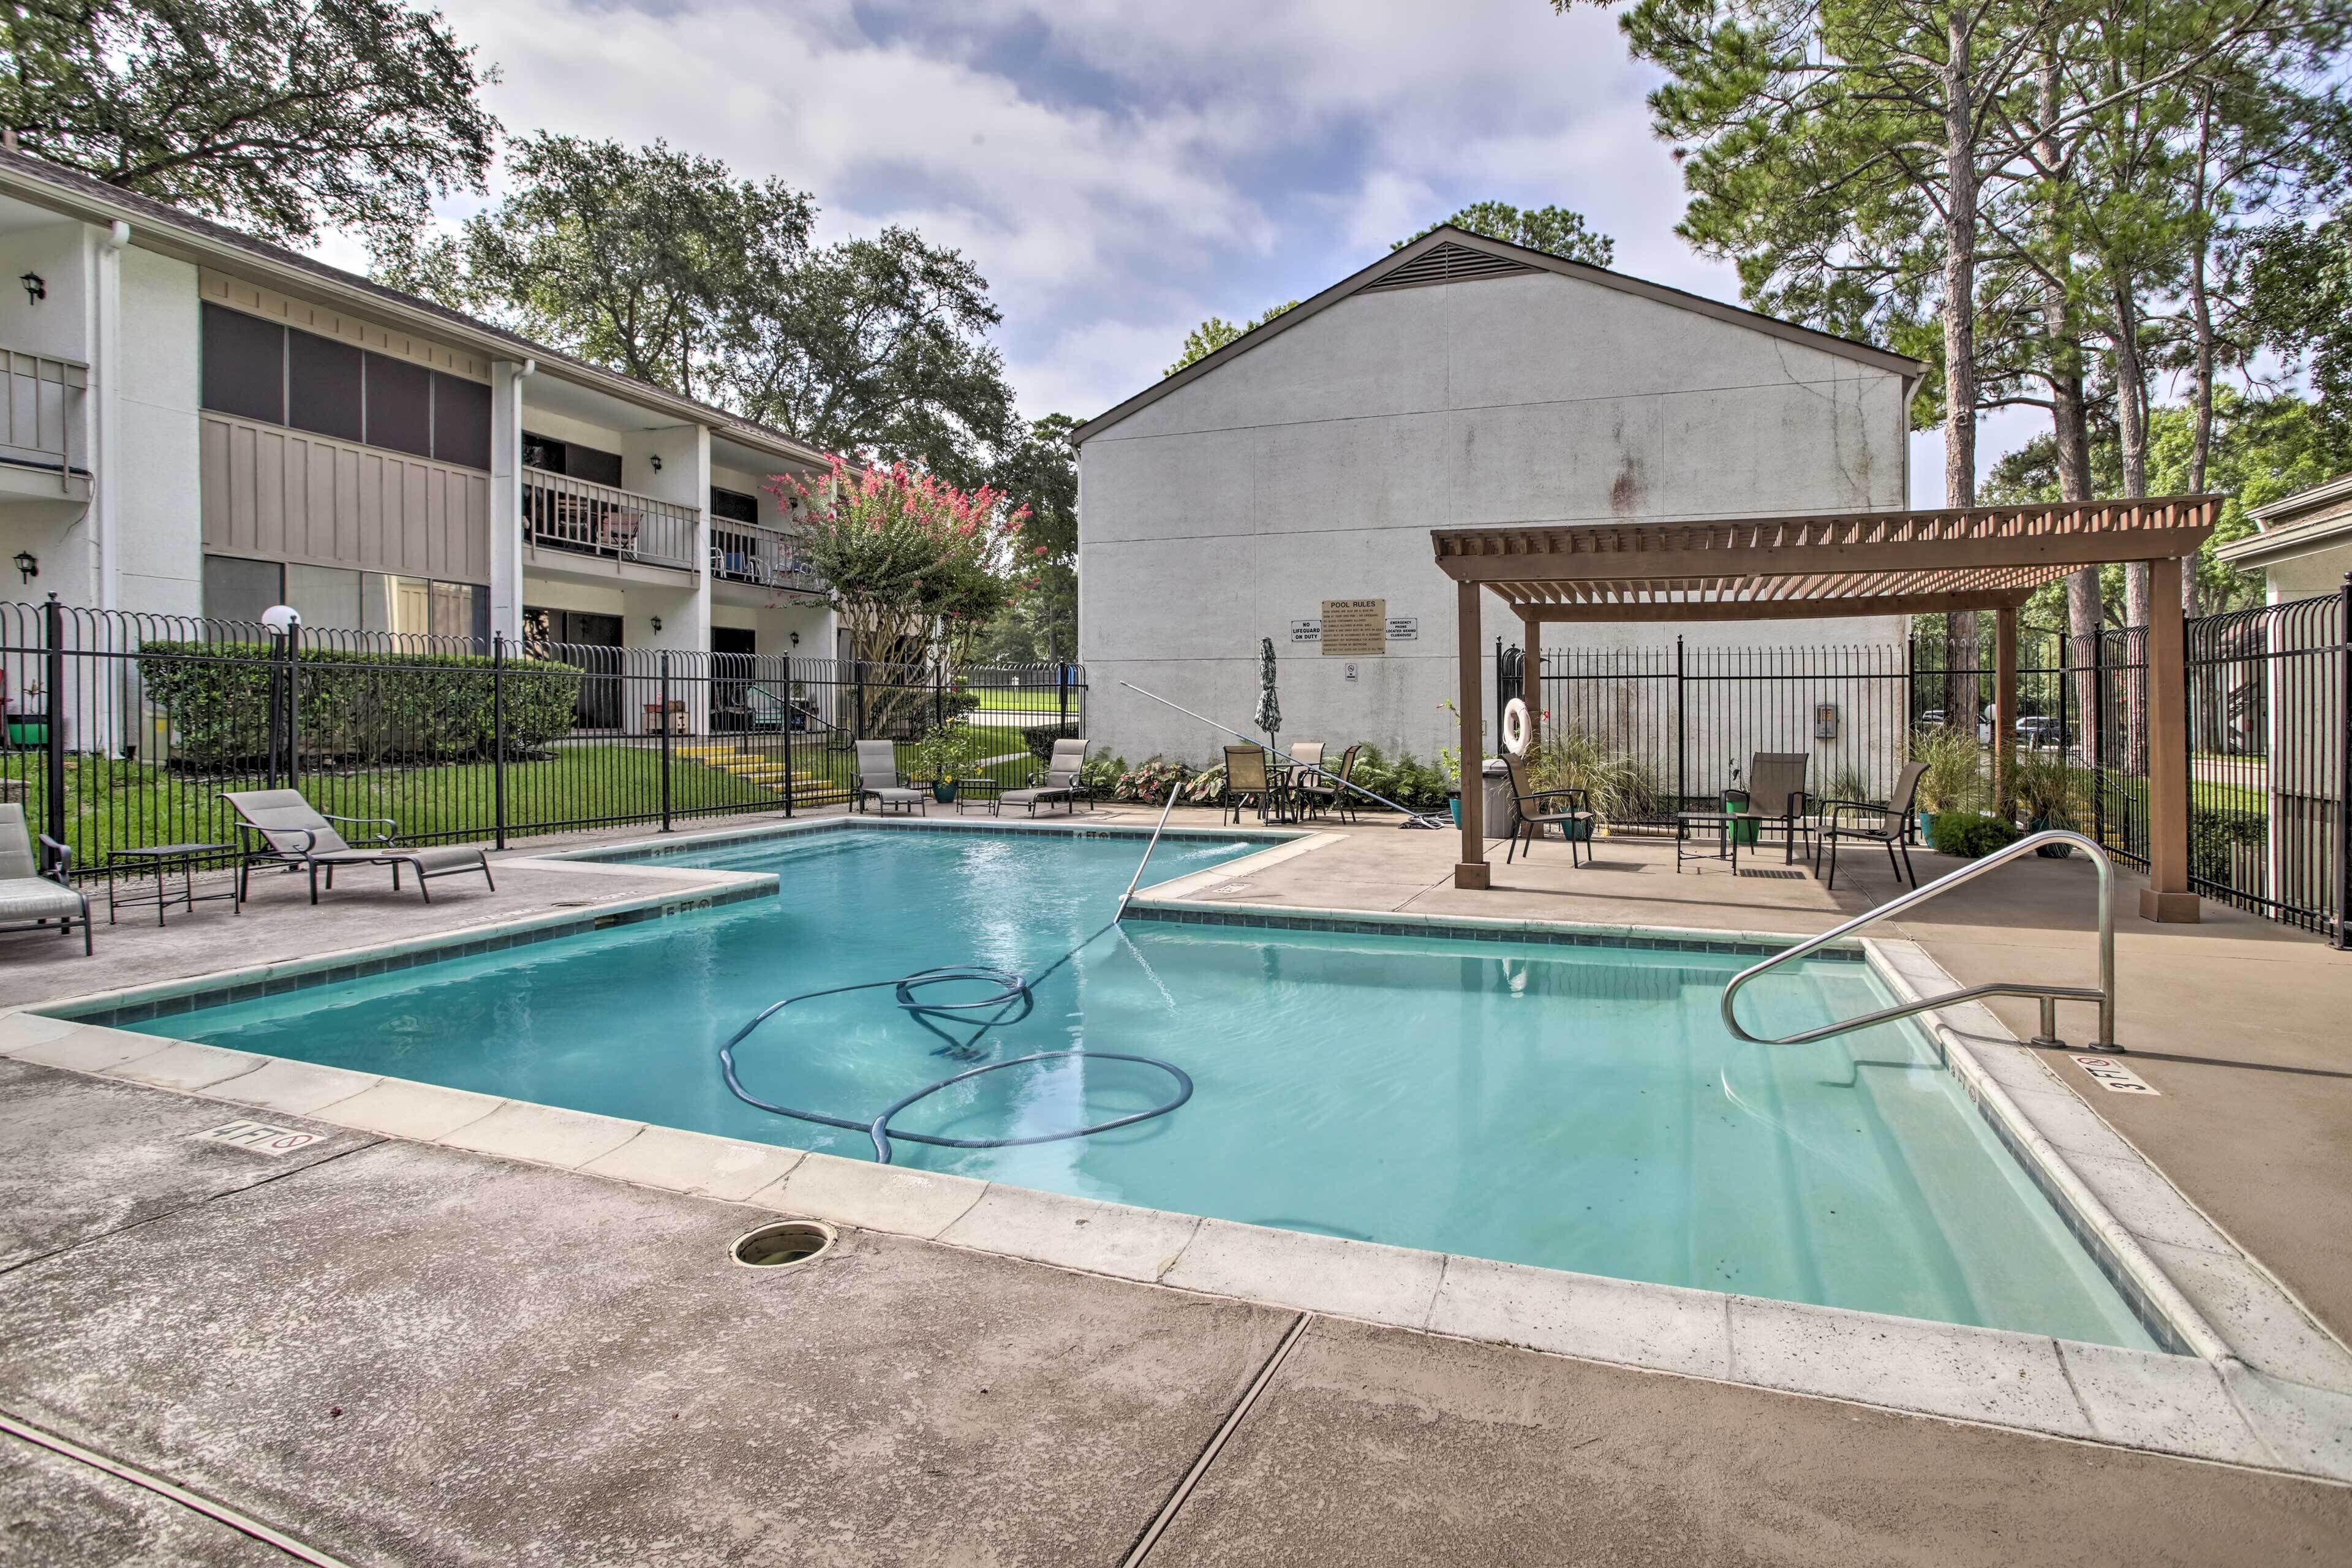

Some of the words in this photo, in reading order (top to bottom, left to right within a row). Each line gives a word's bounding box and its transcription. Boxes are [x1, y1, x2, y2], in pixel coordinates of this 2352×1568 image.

[680, 900, 694, 912] FT
[2085, 1067, 2129, 1080] FT
[2109, 1082, 2146, 1091] 3
[213, 1124, 252, 1137] 4
[228, 1127, 287, 1144] FT
